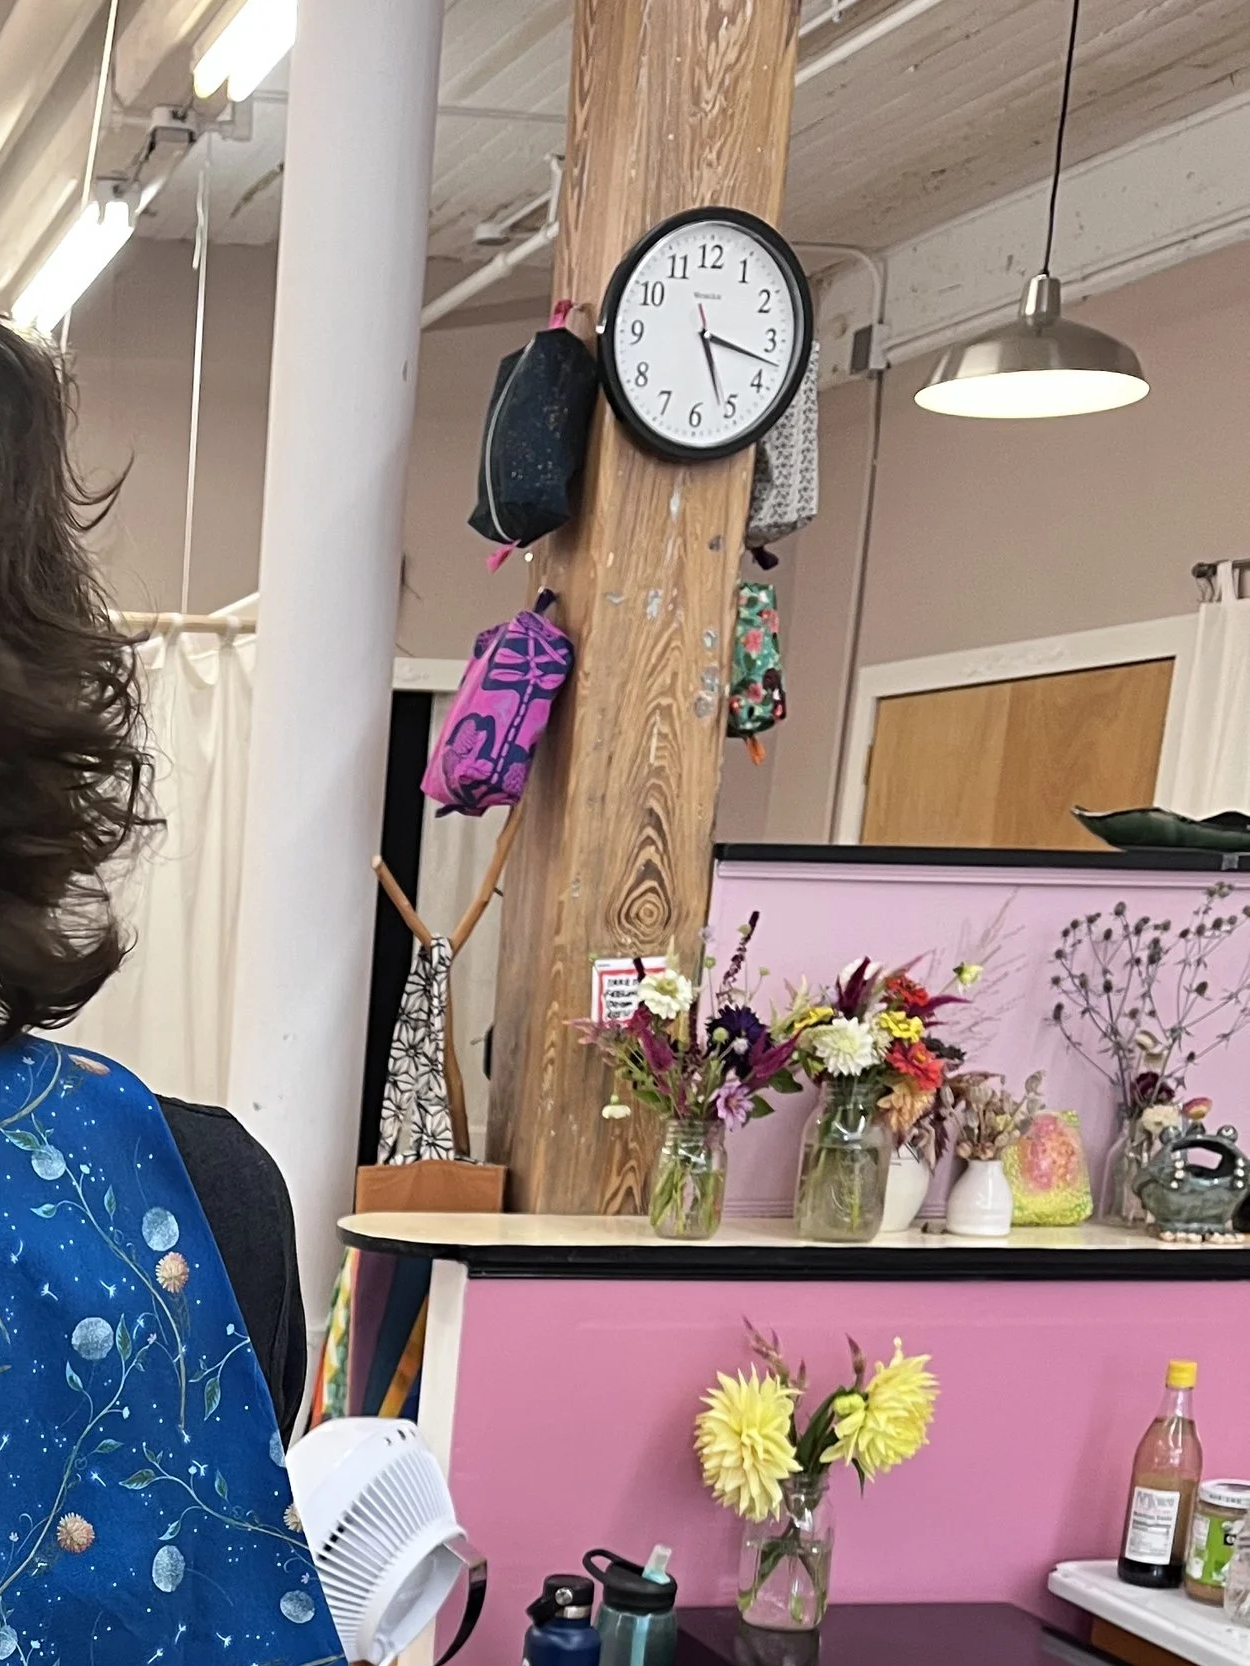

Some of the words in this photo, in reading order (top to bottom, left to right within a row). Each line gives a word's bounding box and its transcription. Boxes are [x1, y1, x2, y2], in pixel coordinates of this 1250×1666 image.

[667, 253, 689, 279] 11
[697, 243, 724, 269] 12
[738, 258, 748, 284] 1
[639, 281, 665, 307] 10
[757, 288, 771, 313] 2
[630, 320, 644, 345] 9
[763, 328, 777, 353] 3
[634, 362, 649, 387] 8
[750, 368, 763, 393] 4
[657, 390, 672, 416] 7
[688, 402, 703, 428] 6
[723, 394, 739, 419] 5
